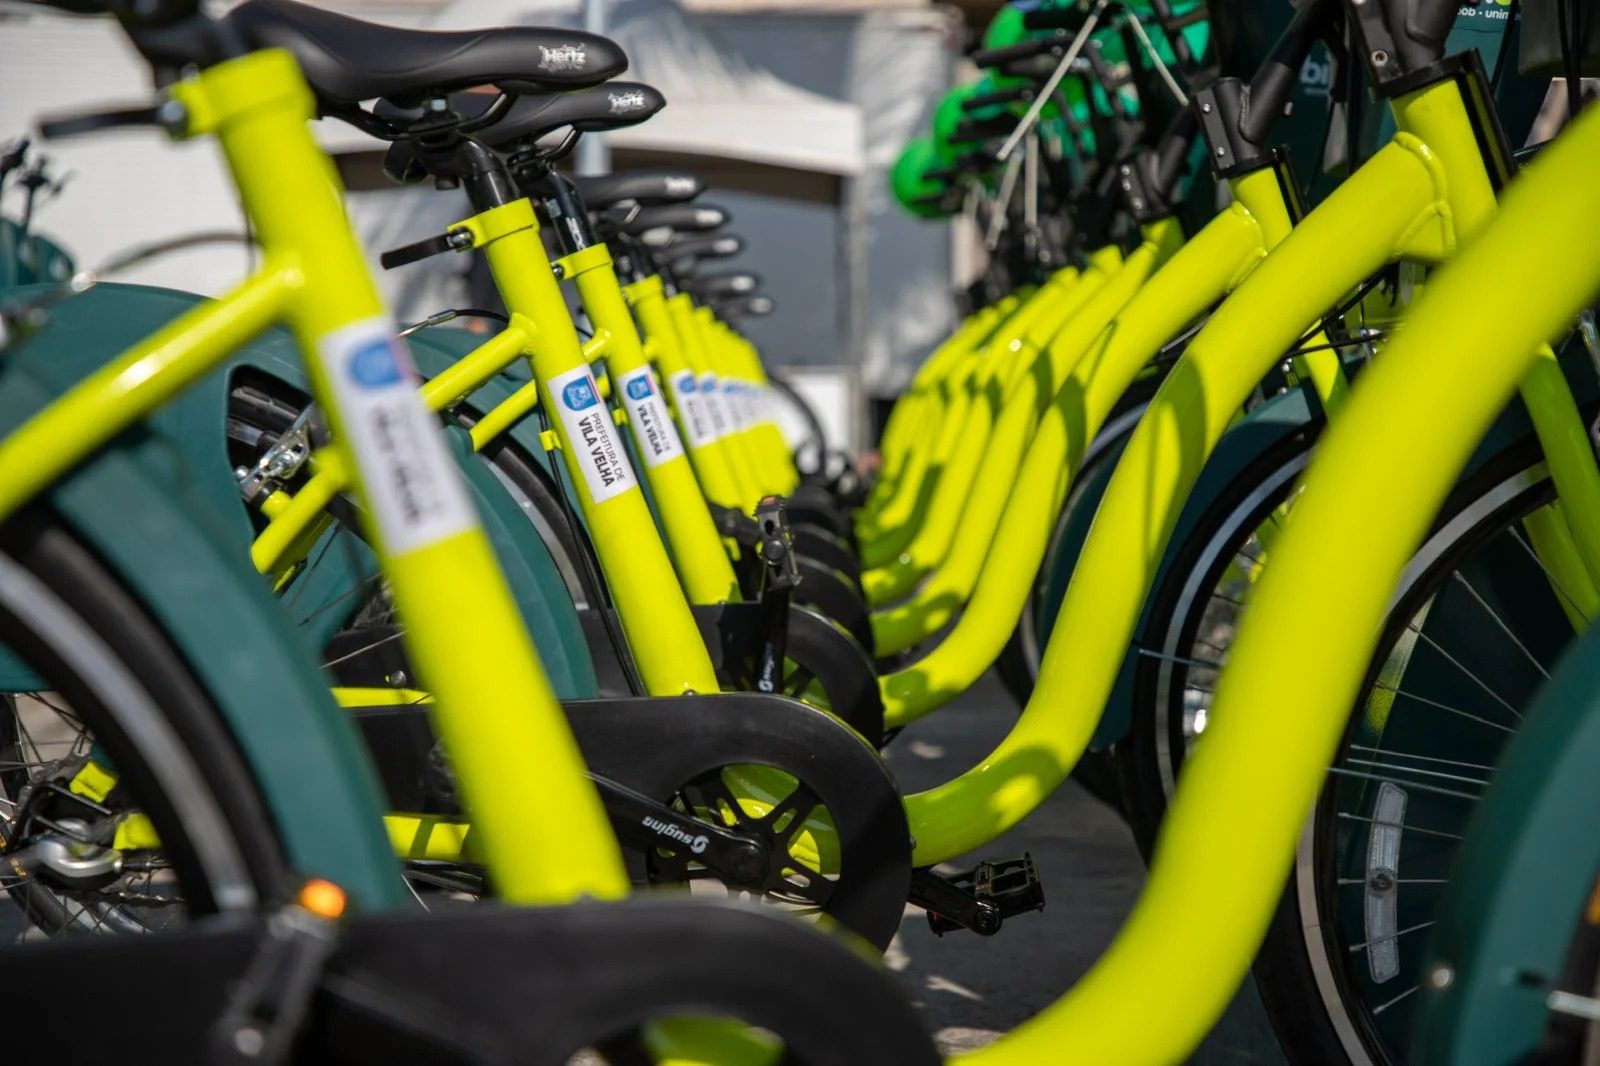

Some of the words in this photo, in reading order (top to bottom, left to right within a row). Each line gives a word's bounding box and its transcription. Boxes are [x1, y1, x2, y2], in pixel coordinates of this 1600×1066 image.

[539, 44, 586, 67] Hertz
[578, 416, 598, 447] VILA
[591, 446, 615, 487] VELHA
[591, 412, 618, 467] PREFEITURA
[614, 467, 625, 482] DE
[637, 404, 651, 427] VILA
[646, 426, 663, 456] VELHA
